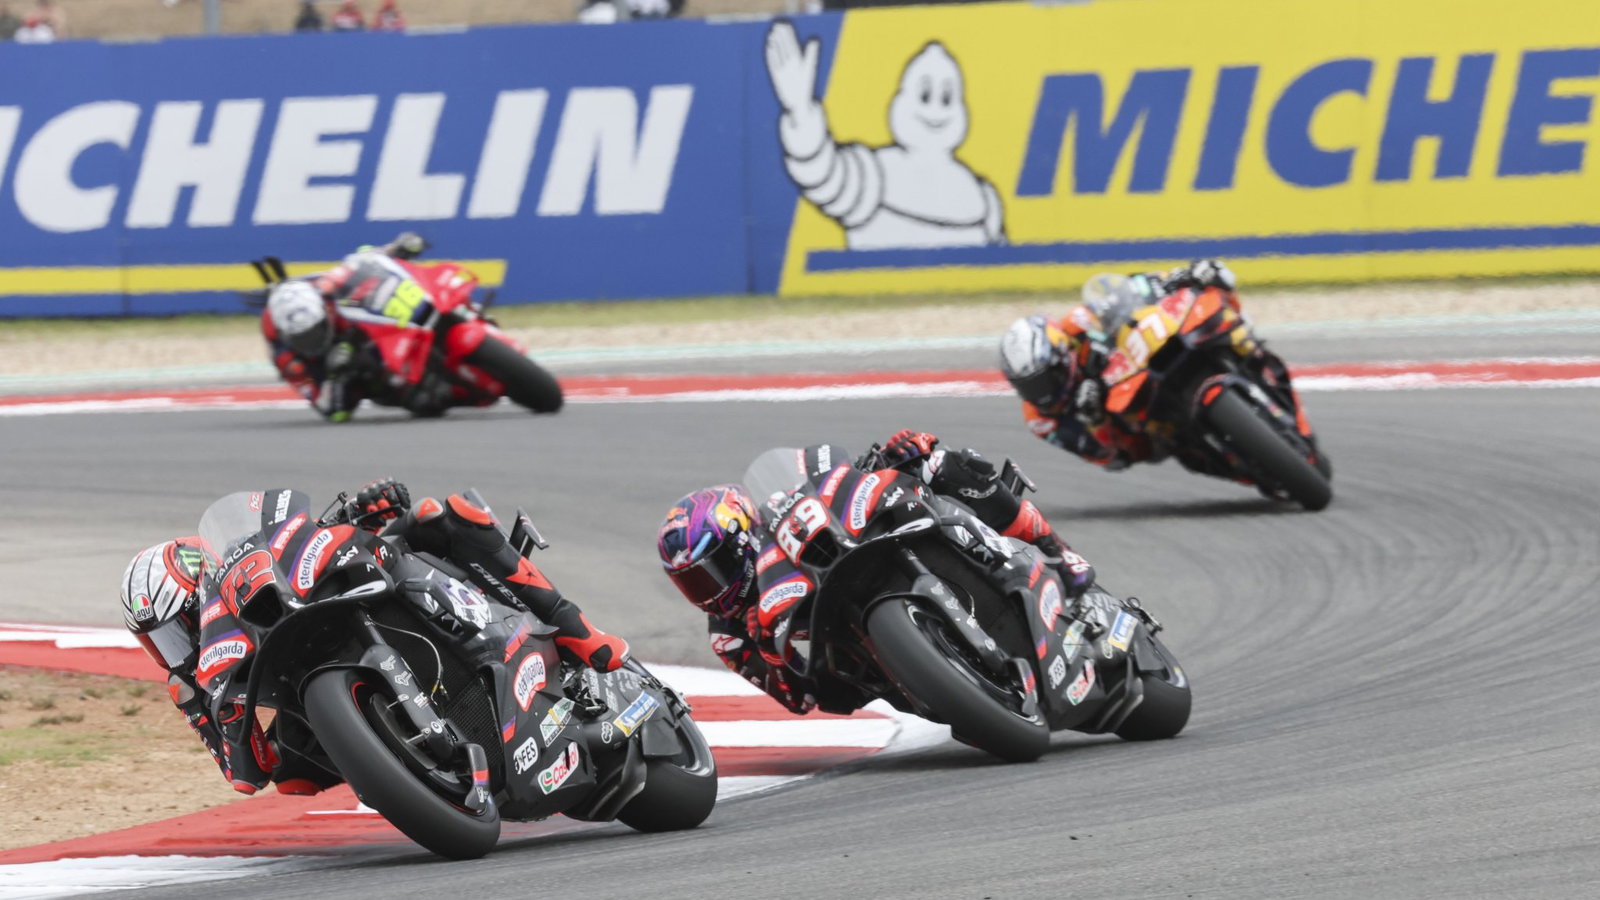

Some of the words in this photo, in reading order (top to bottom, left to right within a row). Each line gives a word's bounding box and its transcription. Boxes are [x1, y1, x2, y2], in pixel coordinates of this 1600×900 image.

[0, 84, 694, 233] CHELIN
[1125, 312, 1169, 368] 37
[299, 532, 330, 587] sterilgarda
[200, 642, 244, 668] sterilgarda
[553, 744, 579, 785] Casol
